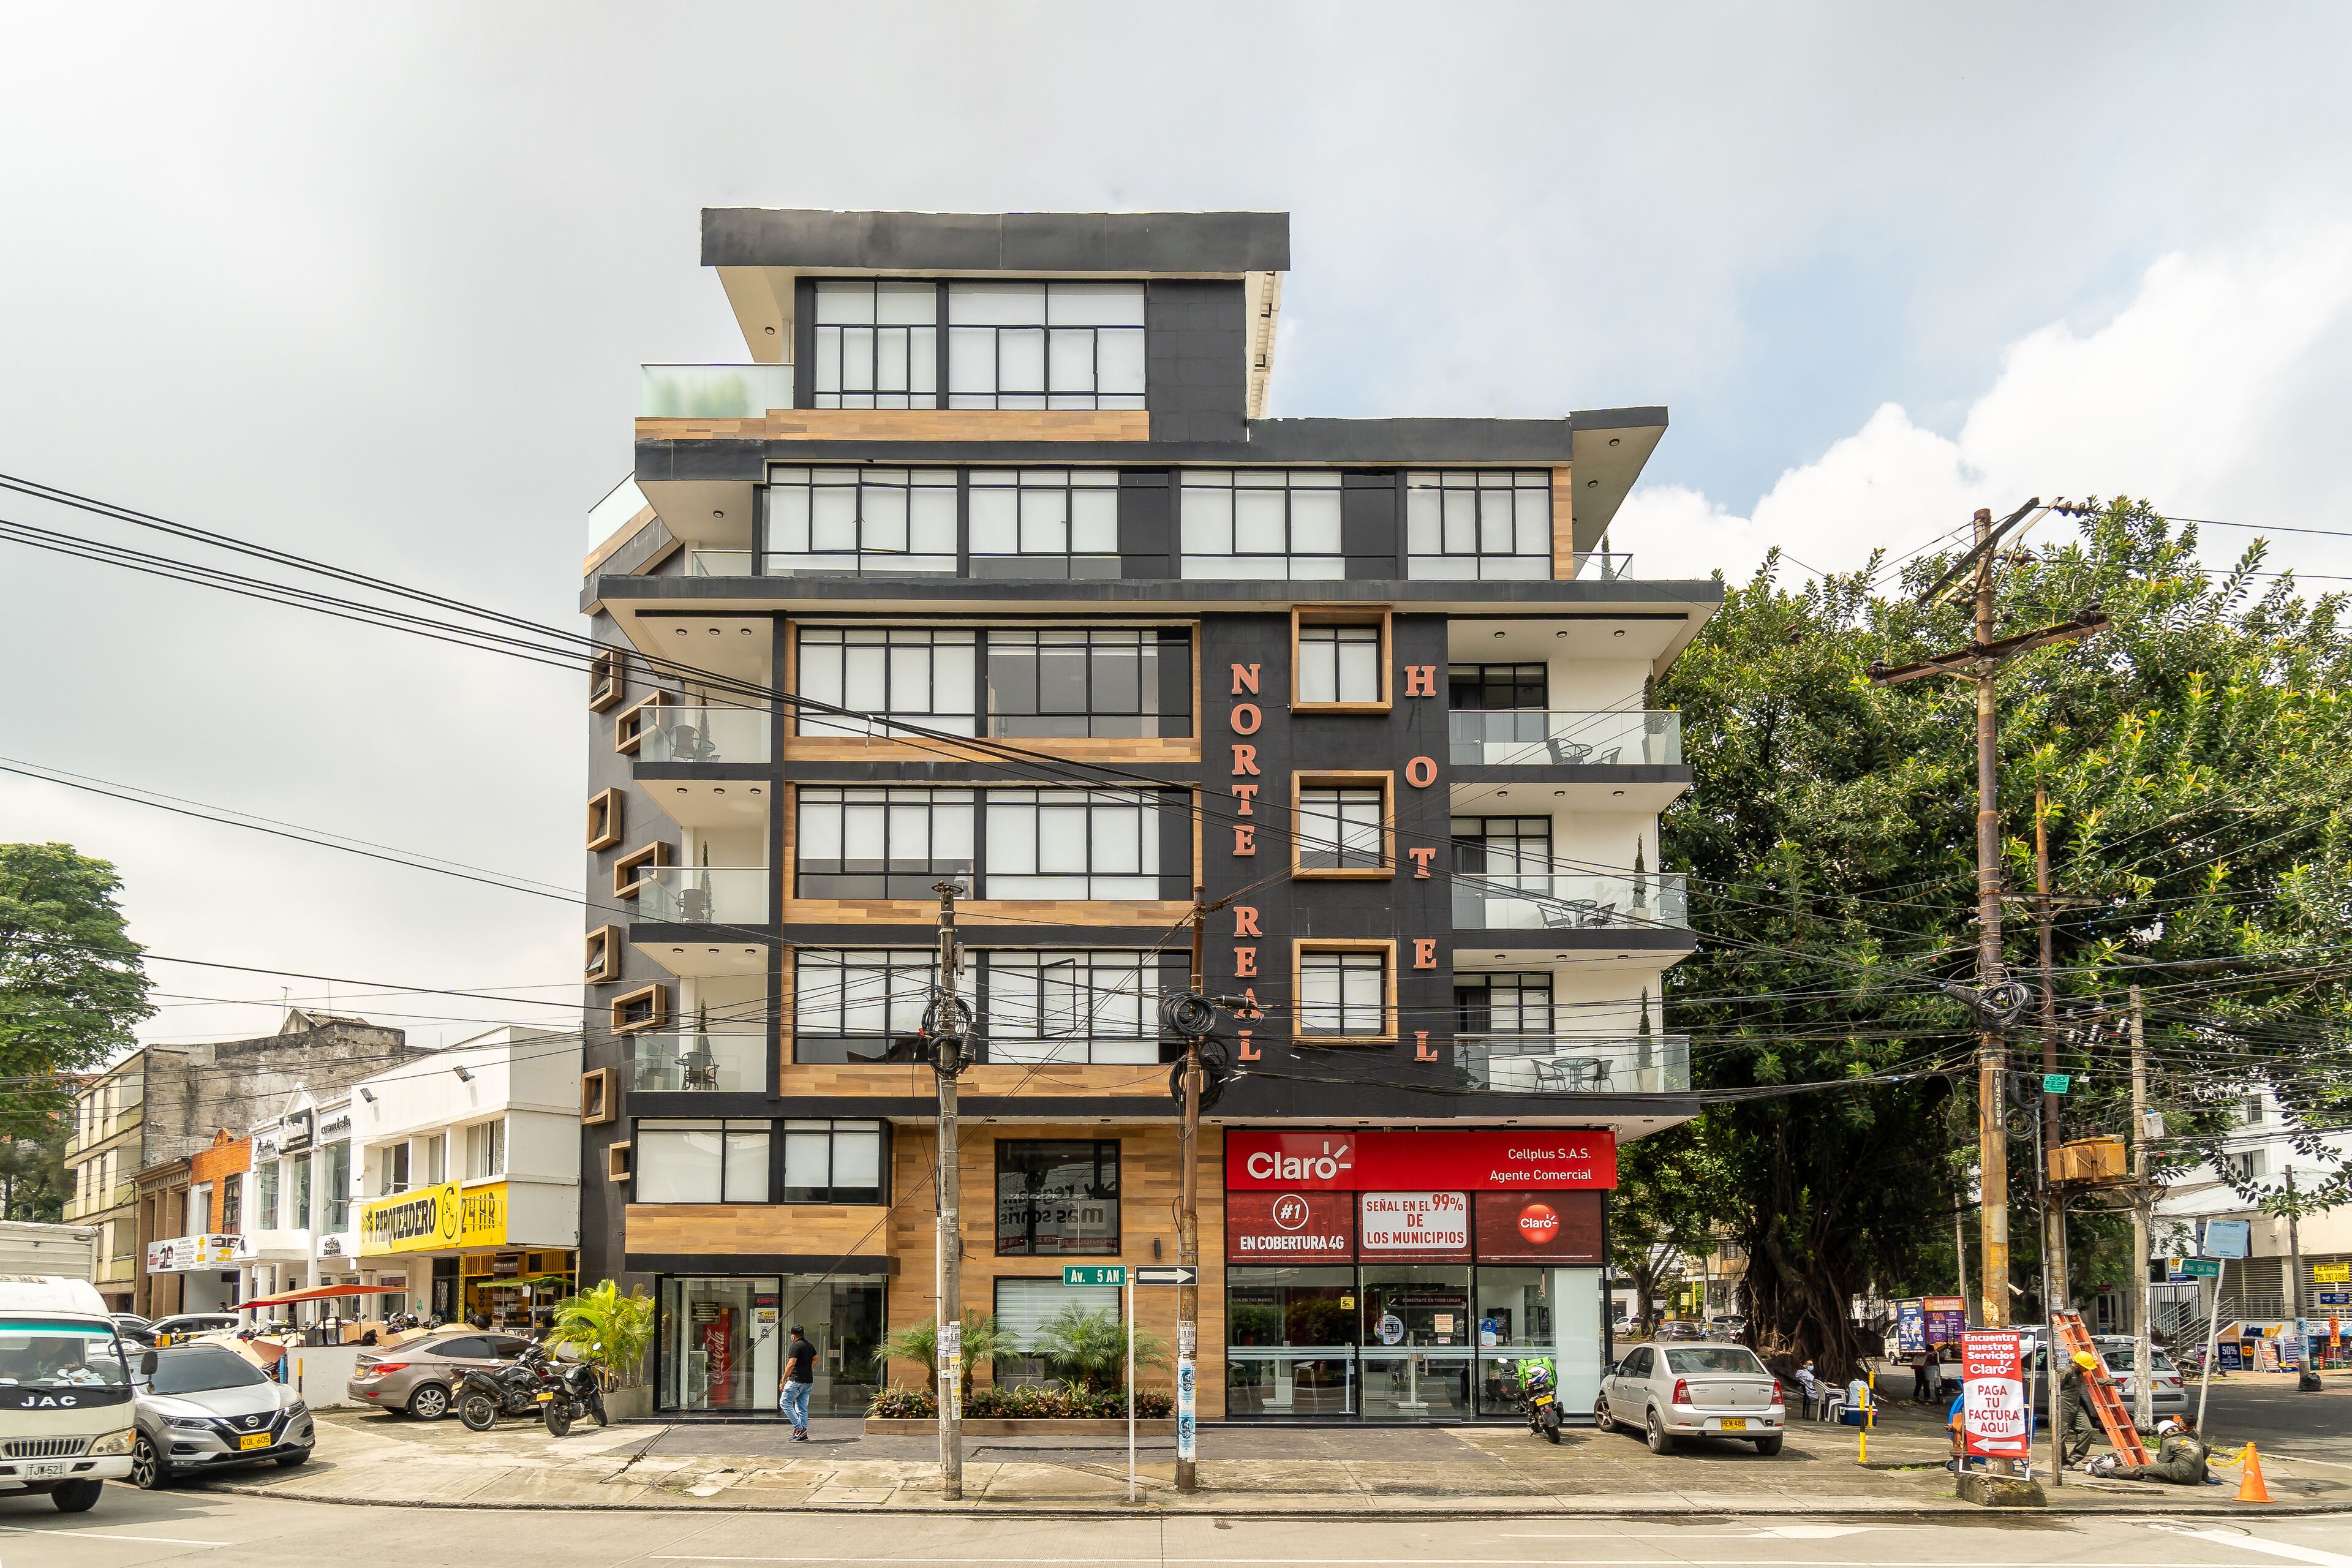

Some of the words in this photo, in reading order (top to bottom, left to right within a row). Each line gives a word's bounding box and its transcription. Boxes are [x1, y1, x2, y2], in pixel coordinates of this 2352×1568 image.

[1231, 663, 1262, 856] NORTE
[1404, 665, 1438, 1062] HOTEL
[1234, 907, 1264, 1061] REAL
[1508, 1148, 1555, 1161] Cellplus
[1558, 1148, 1591, 1159] S.A.S.
[1247, 1146, 1345, 1179] Claro
[1490, 1170, 1530, 1183] Agente
[1534, 1169, 1592, 1180] Comercial
[1366, 1199, 1400, 1212] SEÑAL
[1403, 1200, 1415, 1212] EN
[1419, 1200, 1430, 1212] EL
[1432, 1194, 1463, 1212] 99%
[1281, 1204, 1301, 1219] #1
[375, 1197, 436, 1247] PARQUEADERO
[1407, 1213, 1423, 1227] DE
[1520, 1216, 1555, 1228] Claro
[1240, 1235, 1255, 1250] EN
[1257, 1235, 1327, 1250] COBERTURA
[1329, 1235, 1344, 1250] 4G
[1367, 1231, 1389, 1244] LOS
[1392, 1231, 1464, 1244] MUNICIPIOS
[1071, 1270, 1085, 1283] Av.
[1097, 1270, 1103, 1283] 5
[1106, 1270, 1119, 1283] AN
[1964, 1333, 2018, 1342] Encuentra
[2222, 1346, 2237, 1355] 50%
[1969, 1362, 2011, 1374] Claro
[1978, 1385, 2008, 1396] PAGA
[21, 1396, 77, 1407] JAC
[1985, 1398, 2000, 1408] TU
[1969, 1409, 2020, 1420] FACTURA
[1980, 1420, 2008, 1433] AQUÍ
